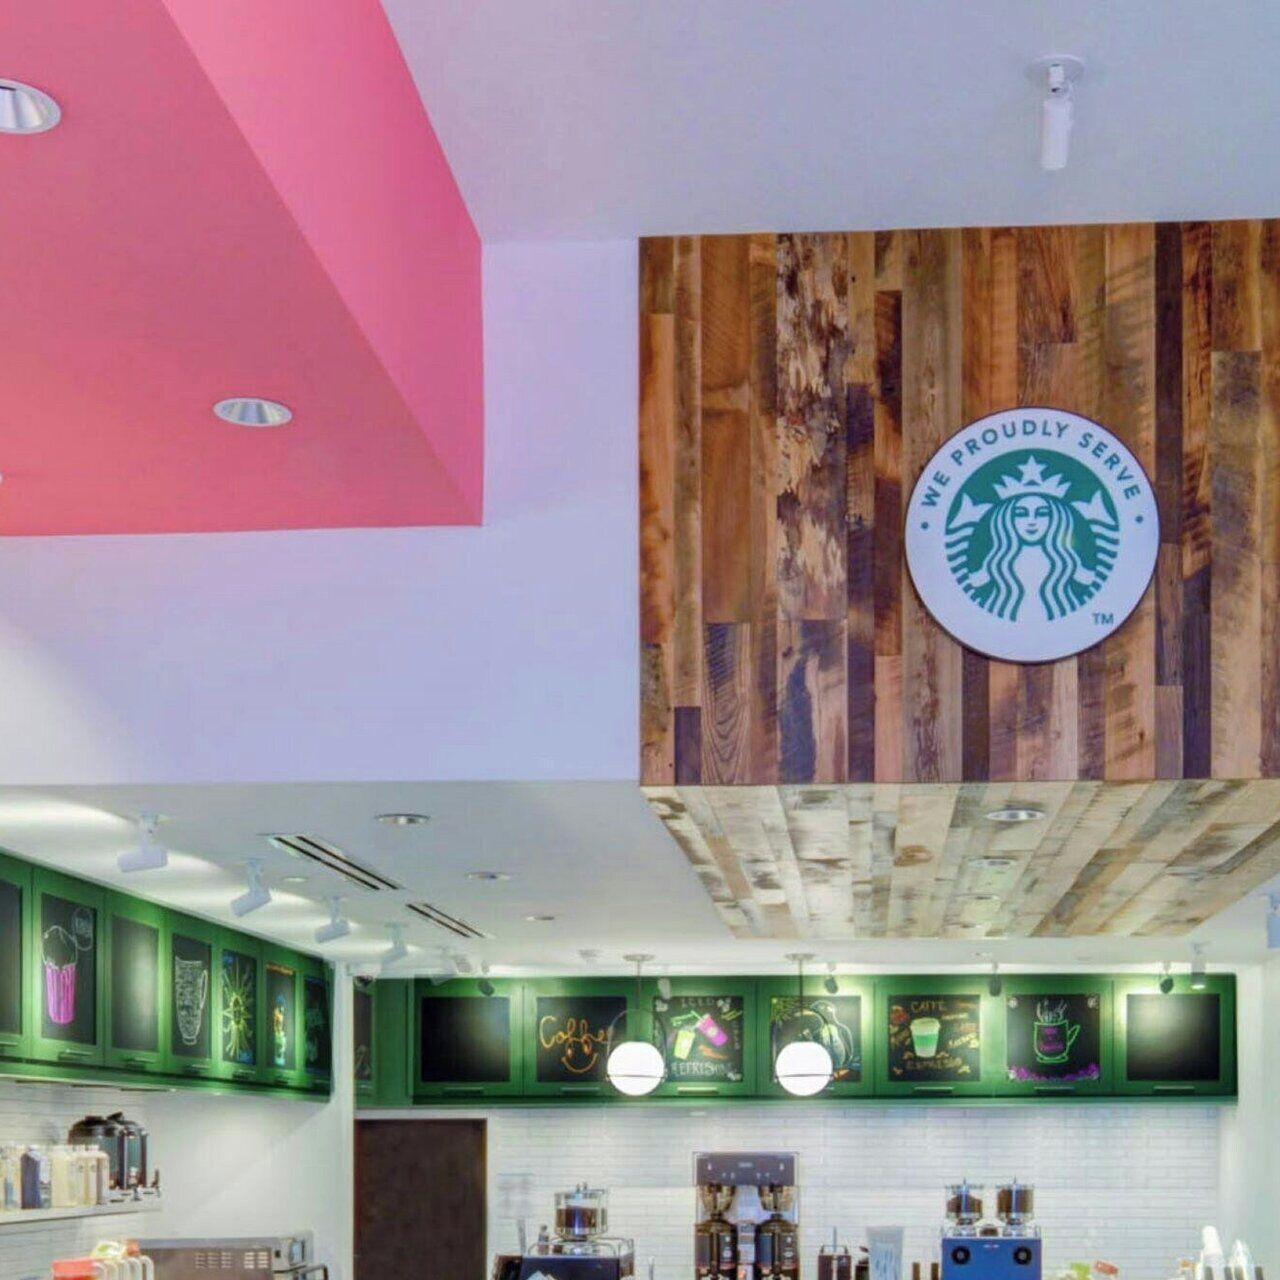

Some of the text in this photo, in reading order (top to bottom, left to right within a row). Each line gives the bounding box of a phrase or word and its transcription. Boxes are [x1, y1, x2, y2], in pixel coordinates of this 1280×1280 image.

[922, 419, 1142, 509] WE PROUDLY SERVE
[1092, 612, 1114, 625] TM
